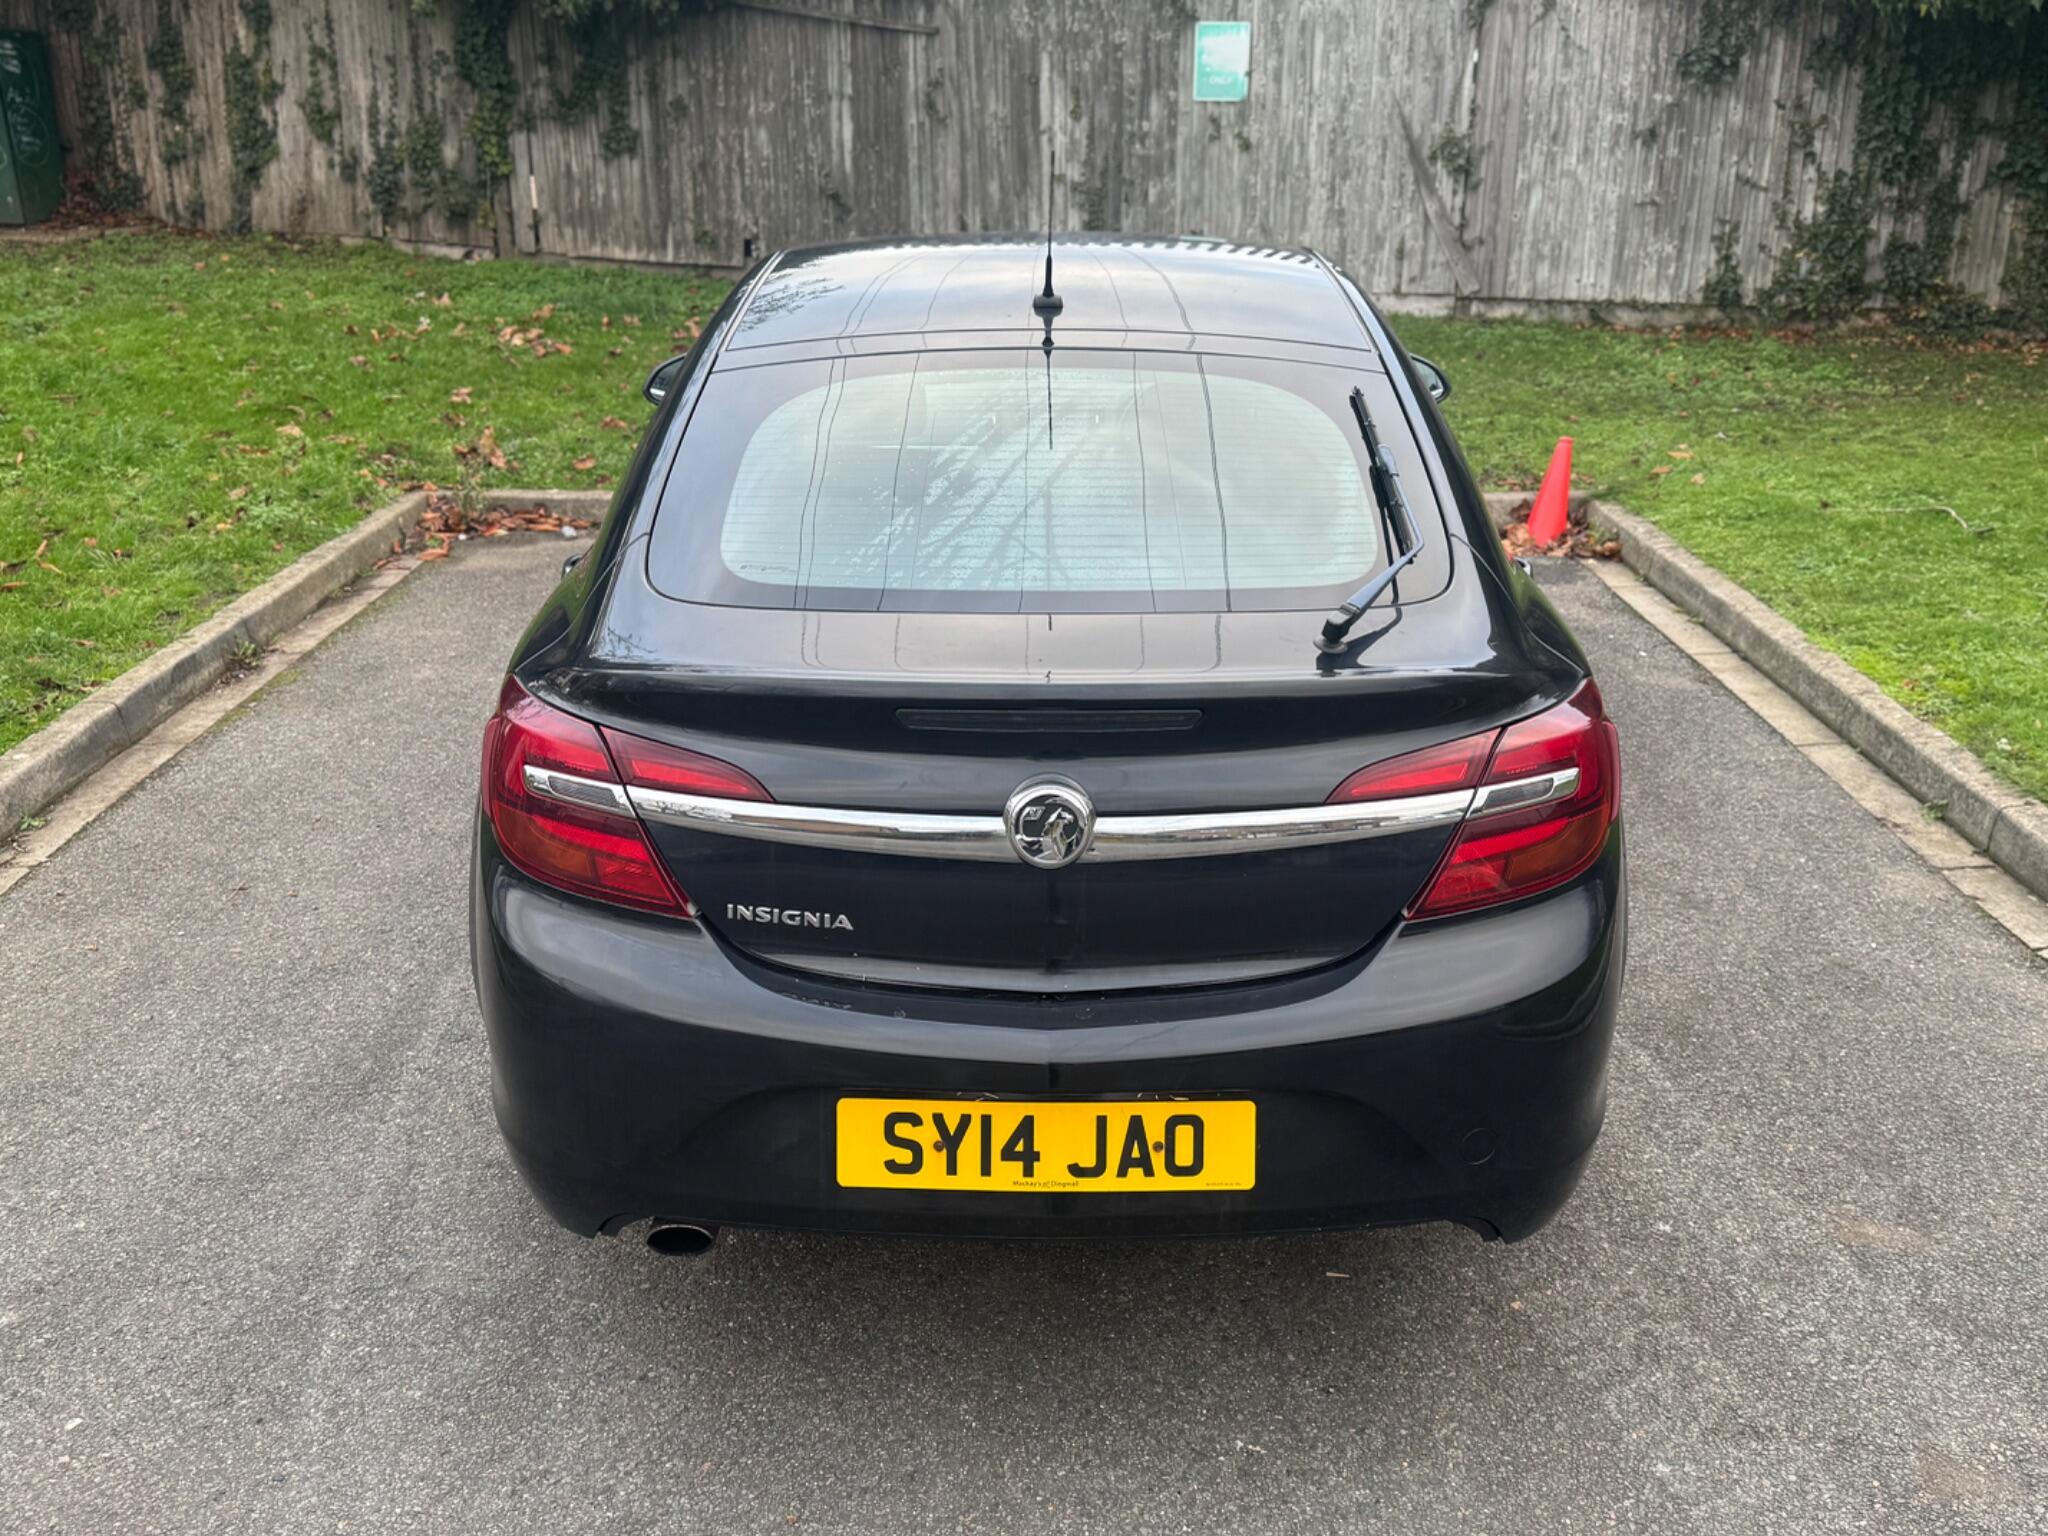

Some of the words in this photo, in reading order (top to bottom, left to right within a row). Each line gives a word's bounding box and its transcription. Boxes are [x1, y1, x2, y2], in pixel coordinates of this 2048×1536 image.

[727, 903, 854, 930] INSIGNIA
[883, 1111, 1041, 1178] SY14
[1066, 1114, 1205, 1178] JAO
